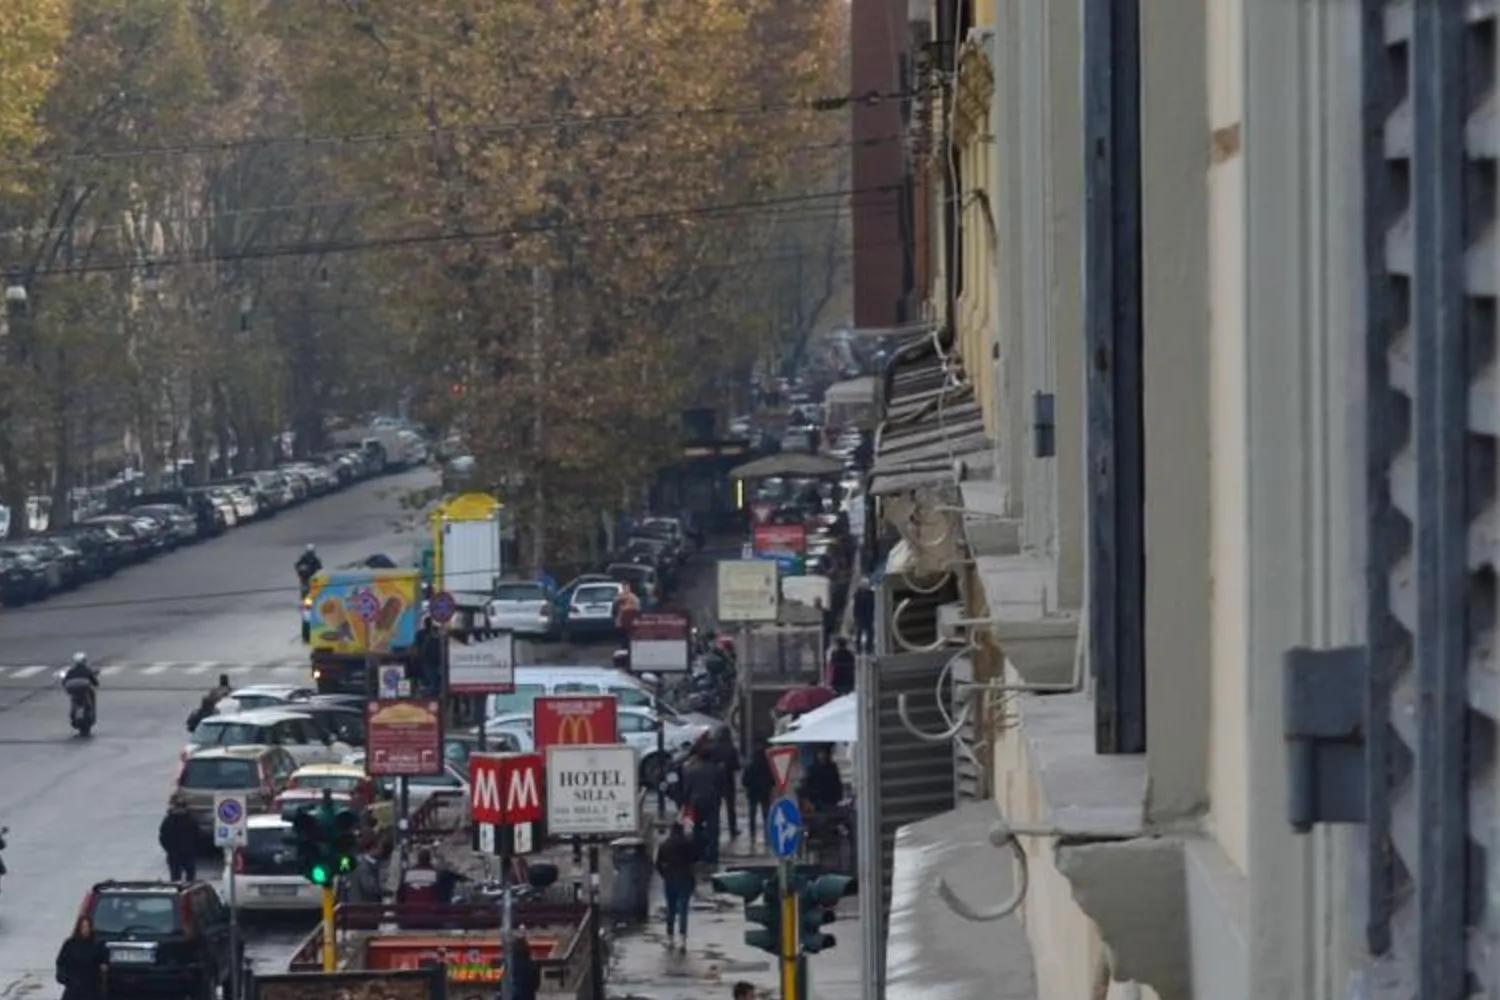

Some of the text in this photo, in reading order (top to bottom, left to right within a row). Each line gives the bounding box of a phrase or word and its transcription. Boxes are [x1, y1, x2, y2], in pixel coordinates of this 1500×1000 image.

[473, 767, 500, 812] M
[506, 767, 540, 811] M
[560, 770, 626, 786] HOTEL
[573, 789, 617, 801] SILLA
